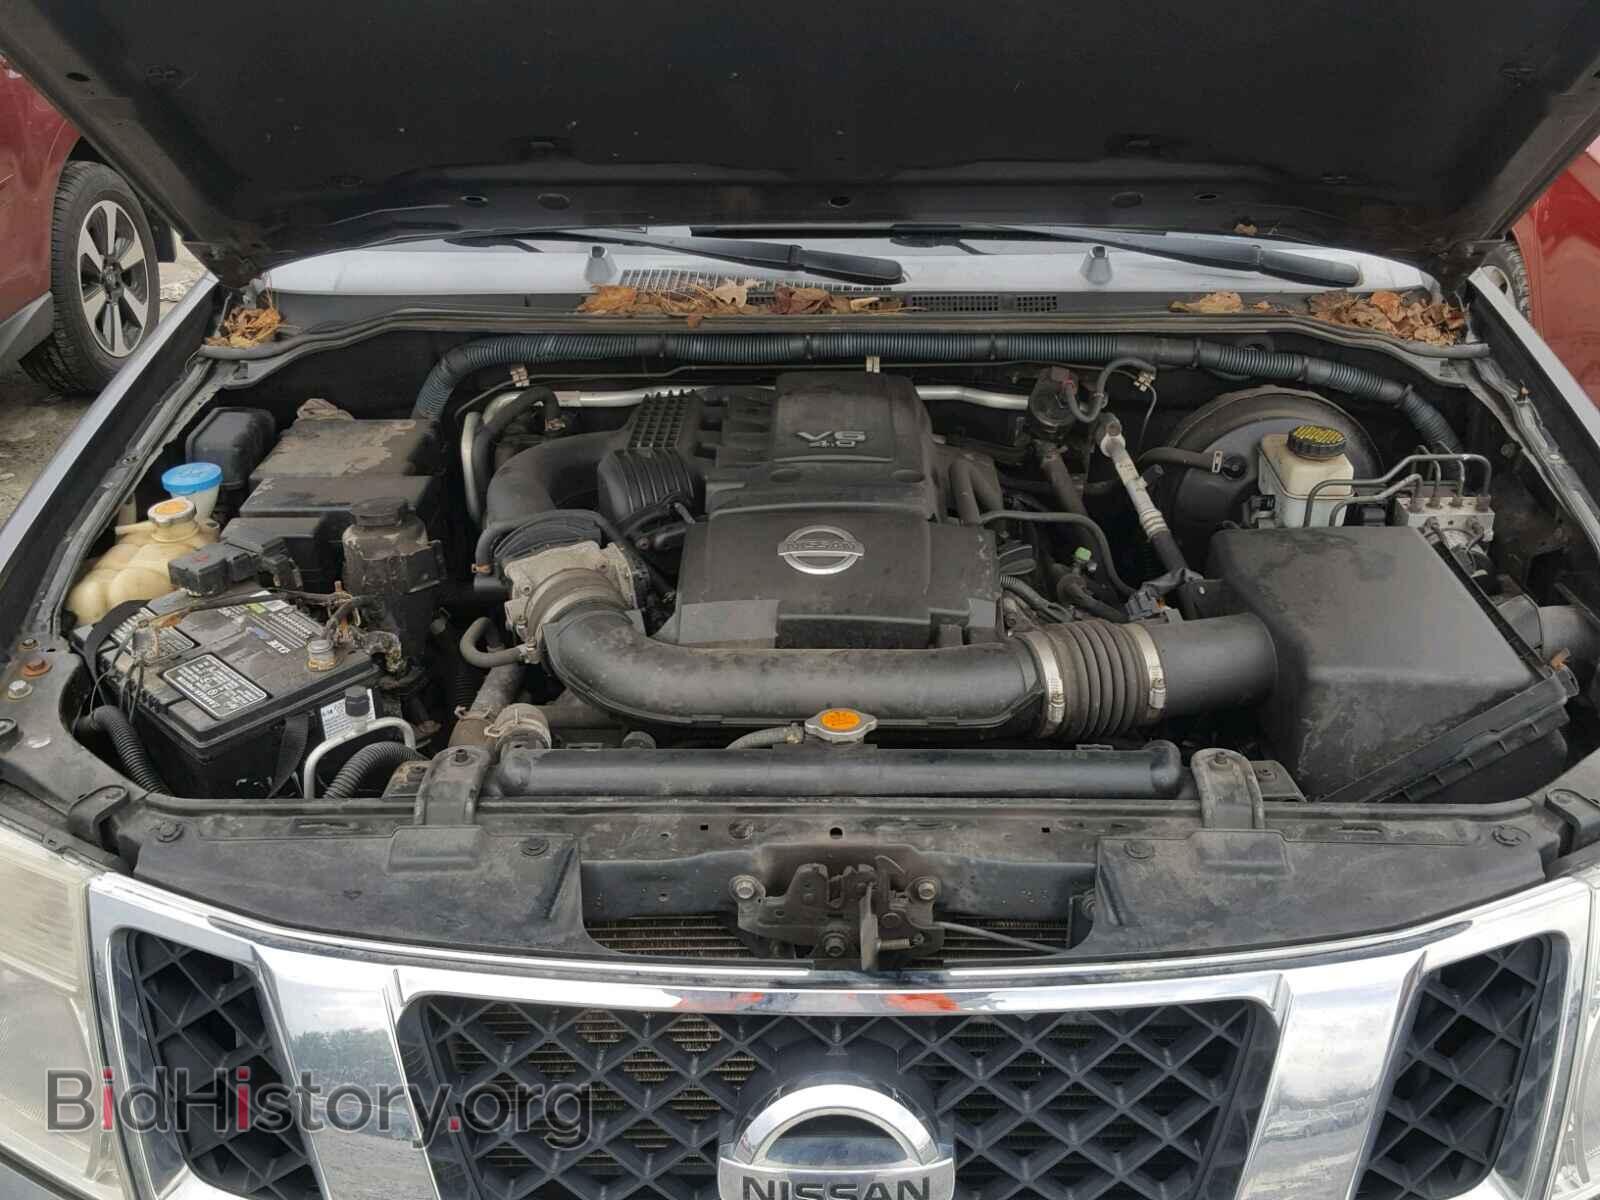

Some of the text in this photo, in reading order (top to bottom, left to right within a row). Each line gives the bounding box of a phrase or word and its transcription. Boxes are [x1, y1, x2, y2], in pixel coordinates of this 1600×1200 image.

[797, 430, 866, 441] V6
[808, 440, 856, 448] 4.0
[784, 540, 857, 552] NISSAN
[742, 1176, 930, 1200] NISSAN
